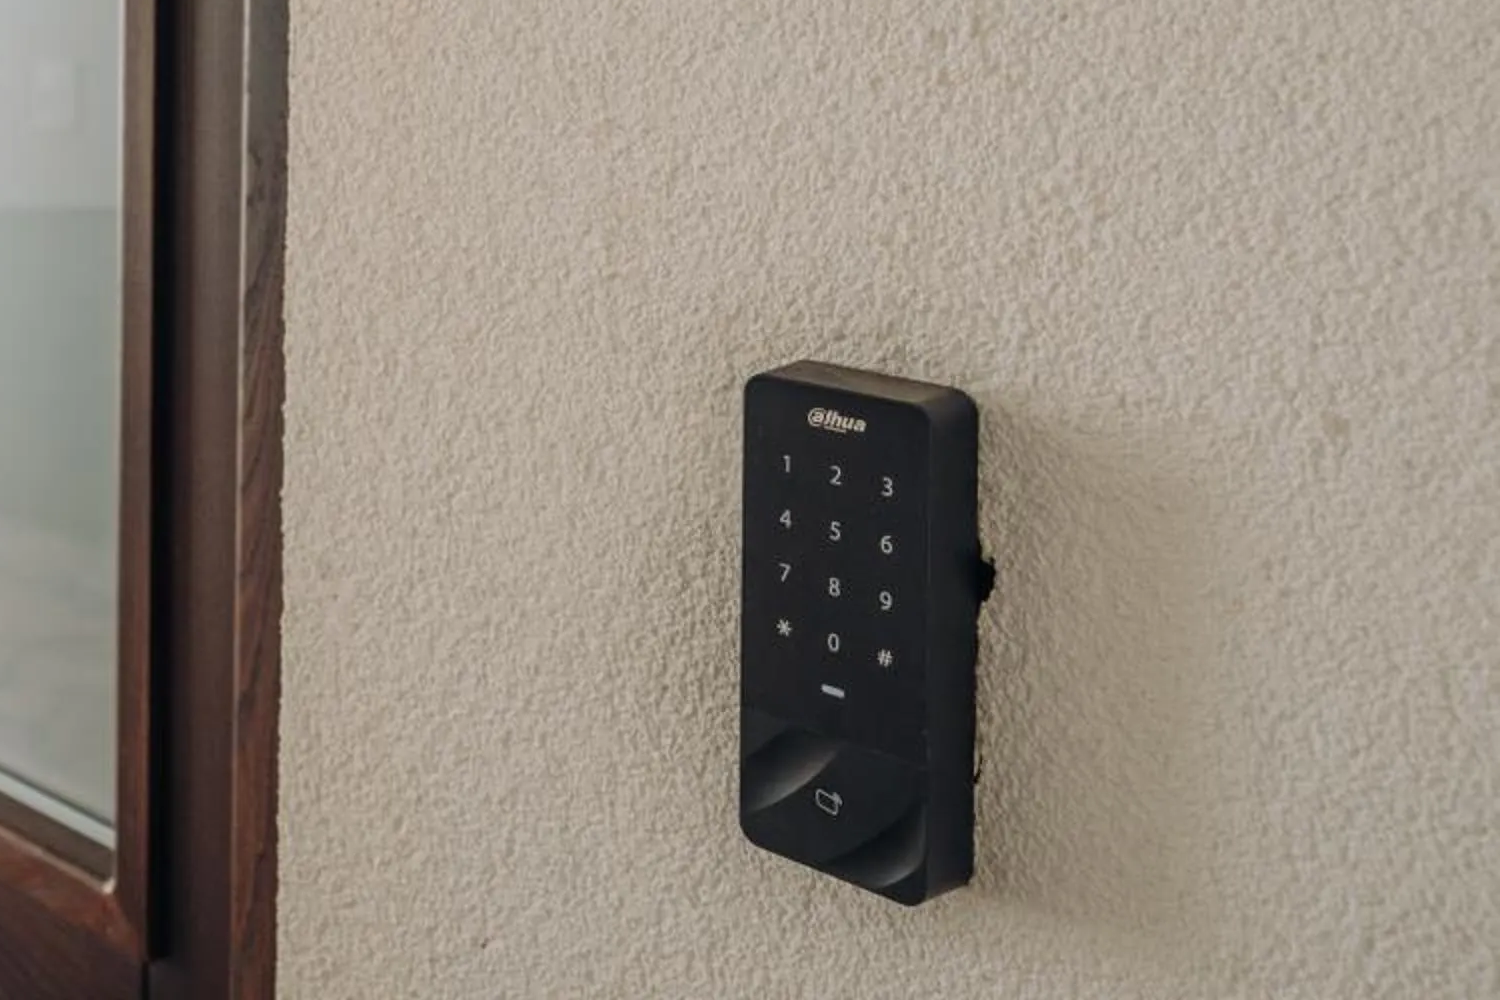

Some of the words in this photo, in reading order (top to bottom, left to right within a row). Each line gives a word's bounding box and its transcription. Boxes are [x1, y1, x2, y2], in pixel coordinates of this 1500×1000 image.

[782, 454, 791, 473] 1
[829, 465, 842, 486] 2
[881, 476, 894, 497] 3
[779, 509, 792, 529] 4
[829, 520, 841, 541] 5
[880, 535, 893, 555] 6
[779, 562, 792, 582] 7
[828, 577, 841, 597] 8
[879, 590, 893, 611] 9
[827, 632, 840, 653] 0
